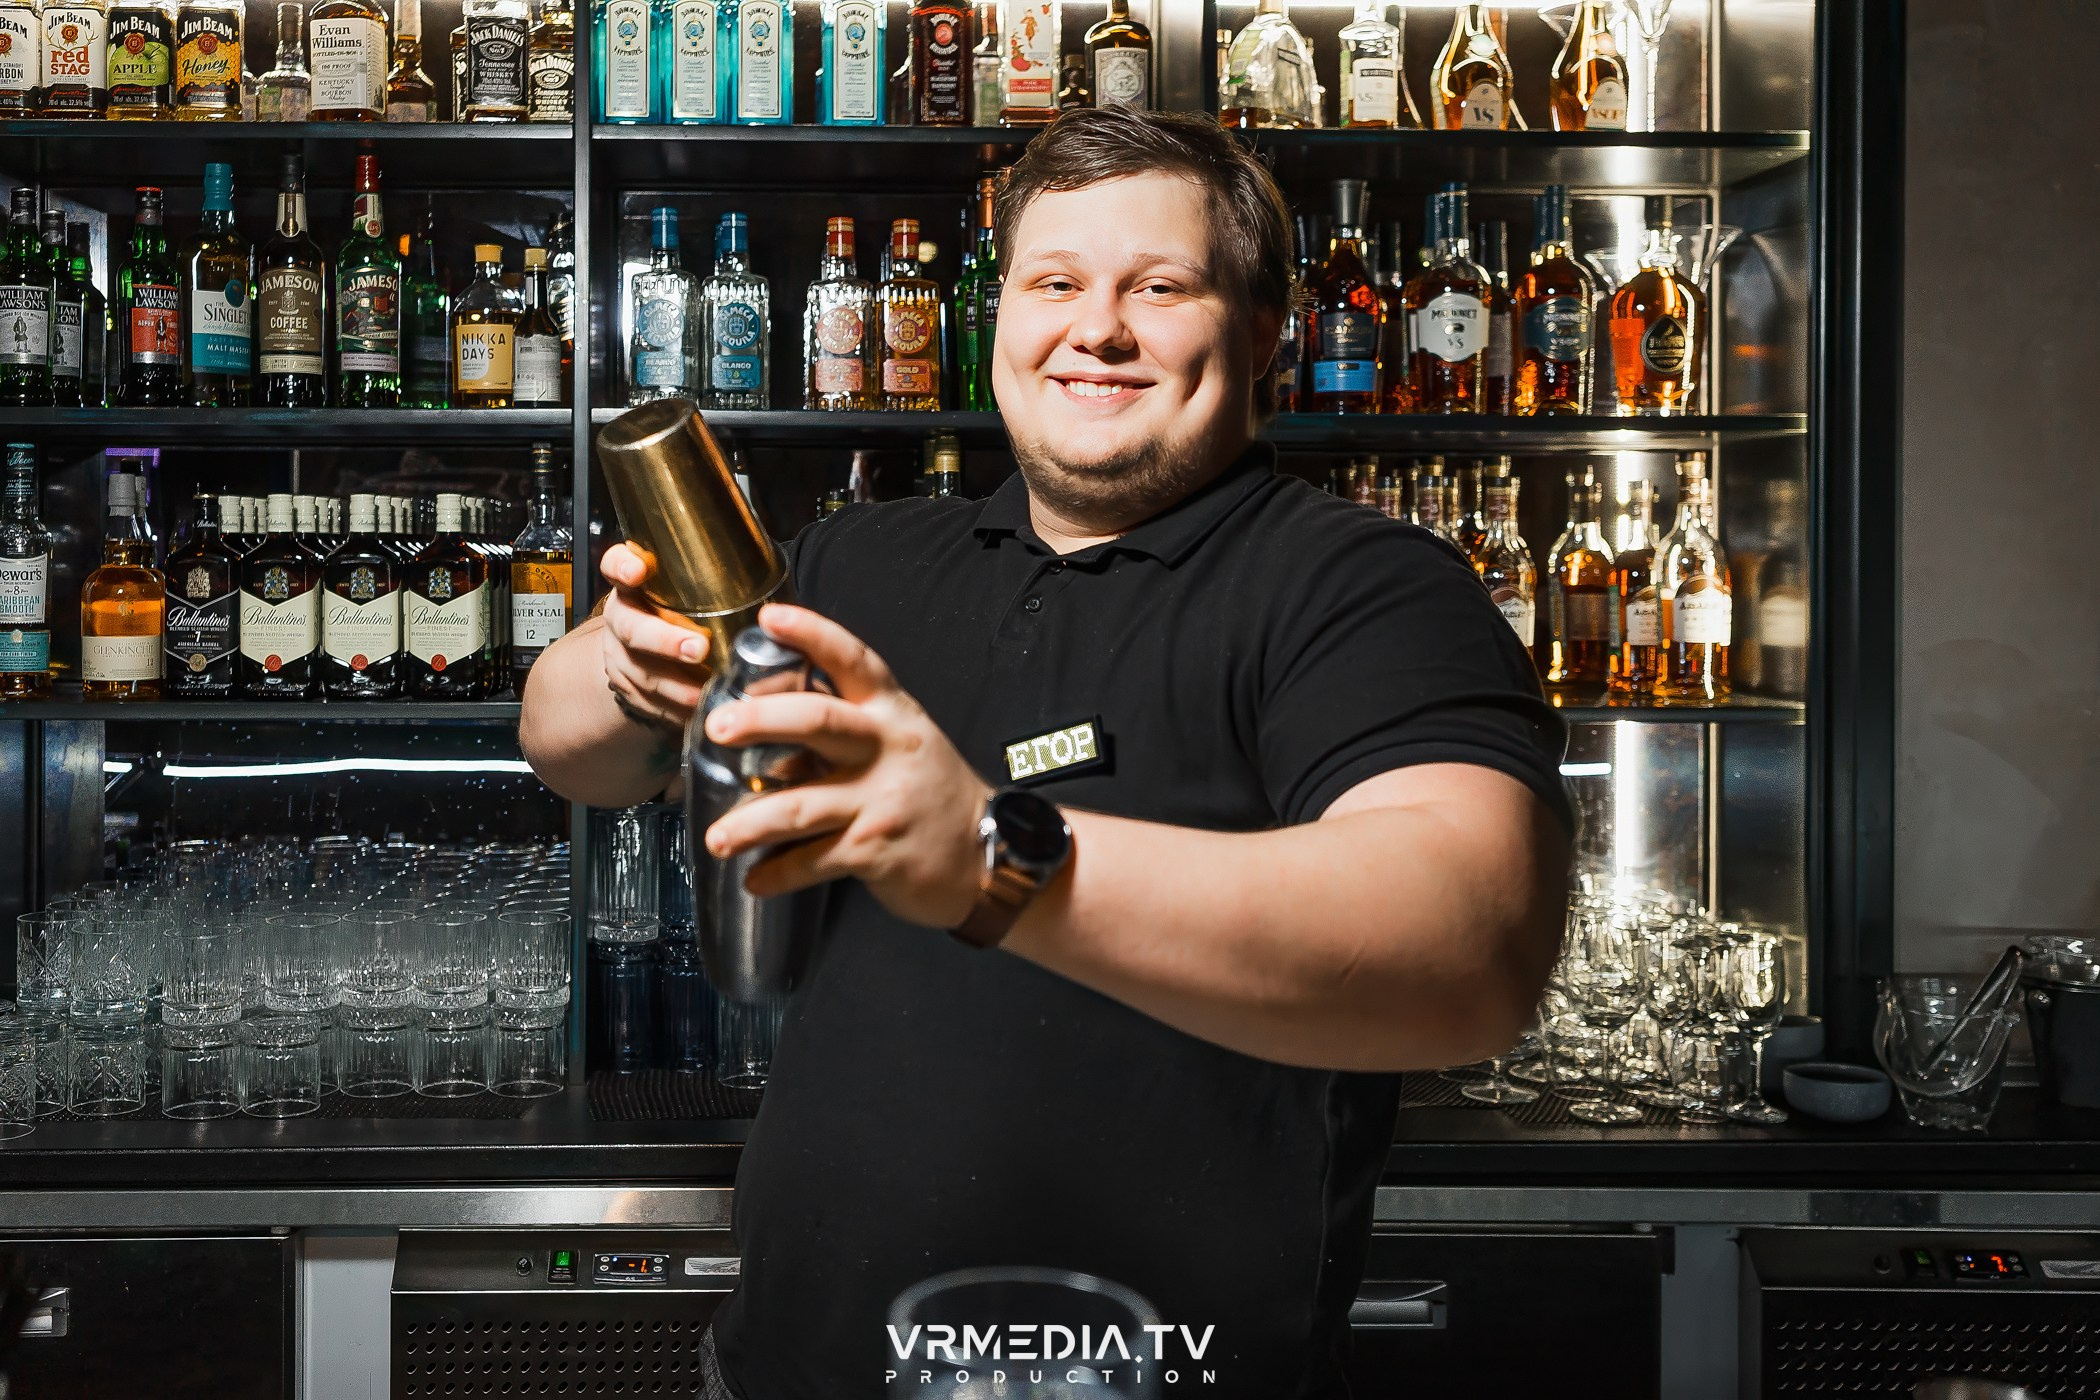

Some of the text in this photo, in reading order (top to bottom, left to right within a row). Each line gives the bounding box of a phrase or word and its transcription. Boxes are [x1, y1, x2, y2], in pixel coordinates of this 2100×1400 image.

[48, 12, 92, 30] JIM BEAM
[110, 16, 160, 40] JIM BEAM
[181, 16, 233, 40] JIM BEAM
[319, 24, 351, 36] Evan
[470, 24, 524, 47] JACK DANIEL'S
[312, 37, 362, 49] Williams
[51, 45, 89, 63] red
[51, 64, 90, 75] STAG
[113, 64, 157, 74] APPLE
[182, 59, 231, 76] Honey
[260, 275, 320, 295] JAMESON
[0, 290, 43, 301] WILLIAM
[139, 288, 179, 301] WILLIAM
[204, 303, 250, 324] SINGLET
[720, 306, 755, 321] OLMECA
[270, 316, 308, 329] COFFEE
[462, 333, 506, 345] NIKKA
[718, 330, 756, 347] TEQUILA
[462, 348, 495, 360] DAYS
[896, 366, 919, 374] GOLD
[13, 585, 20, 595] 8
[0, 604, 34, 613] SMOOTH
[167, 605, 231, 627] Ballantine's
[242, 606, 307, 626] Ballantine's
[328, 606, 393, 626] Ballantine's
[411, 606, 470, 626] Ballantine's
[512, 608, 564, 618] ILVER SEAL
[526, 629, 536, 640] 12
[1008, 725, 1095, 779] ЕГОР
